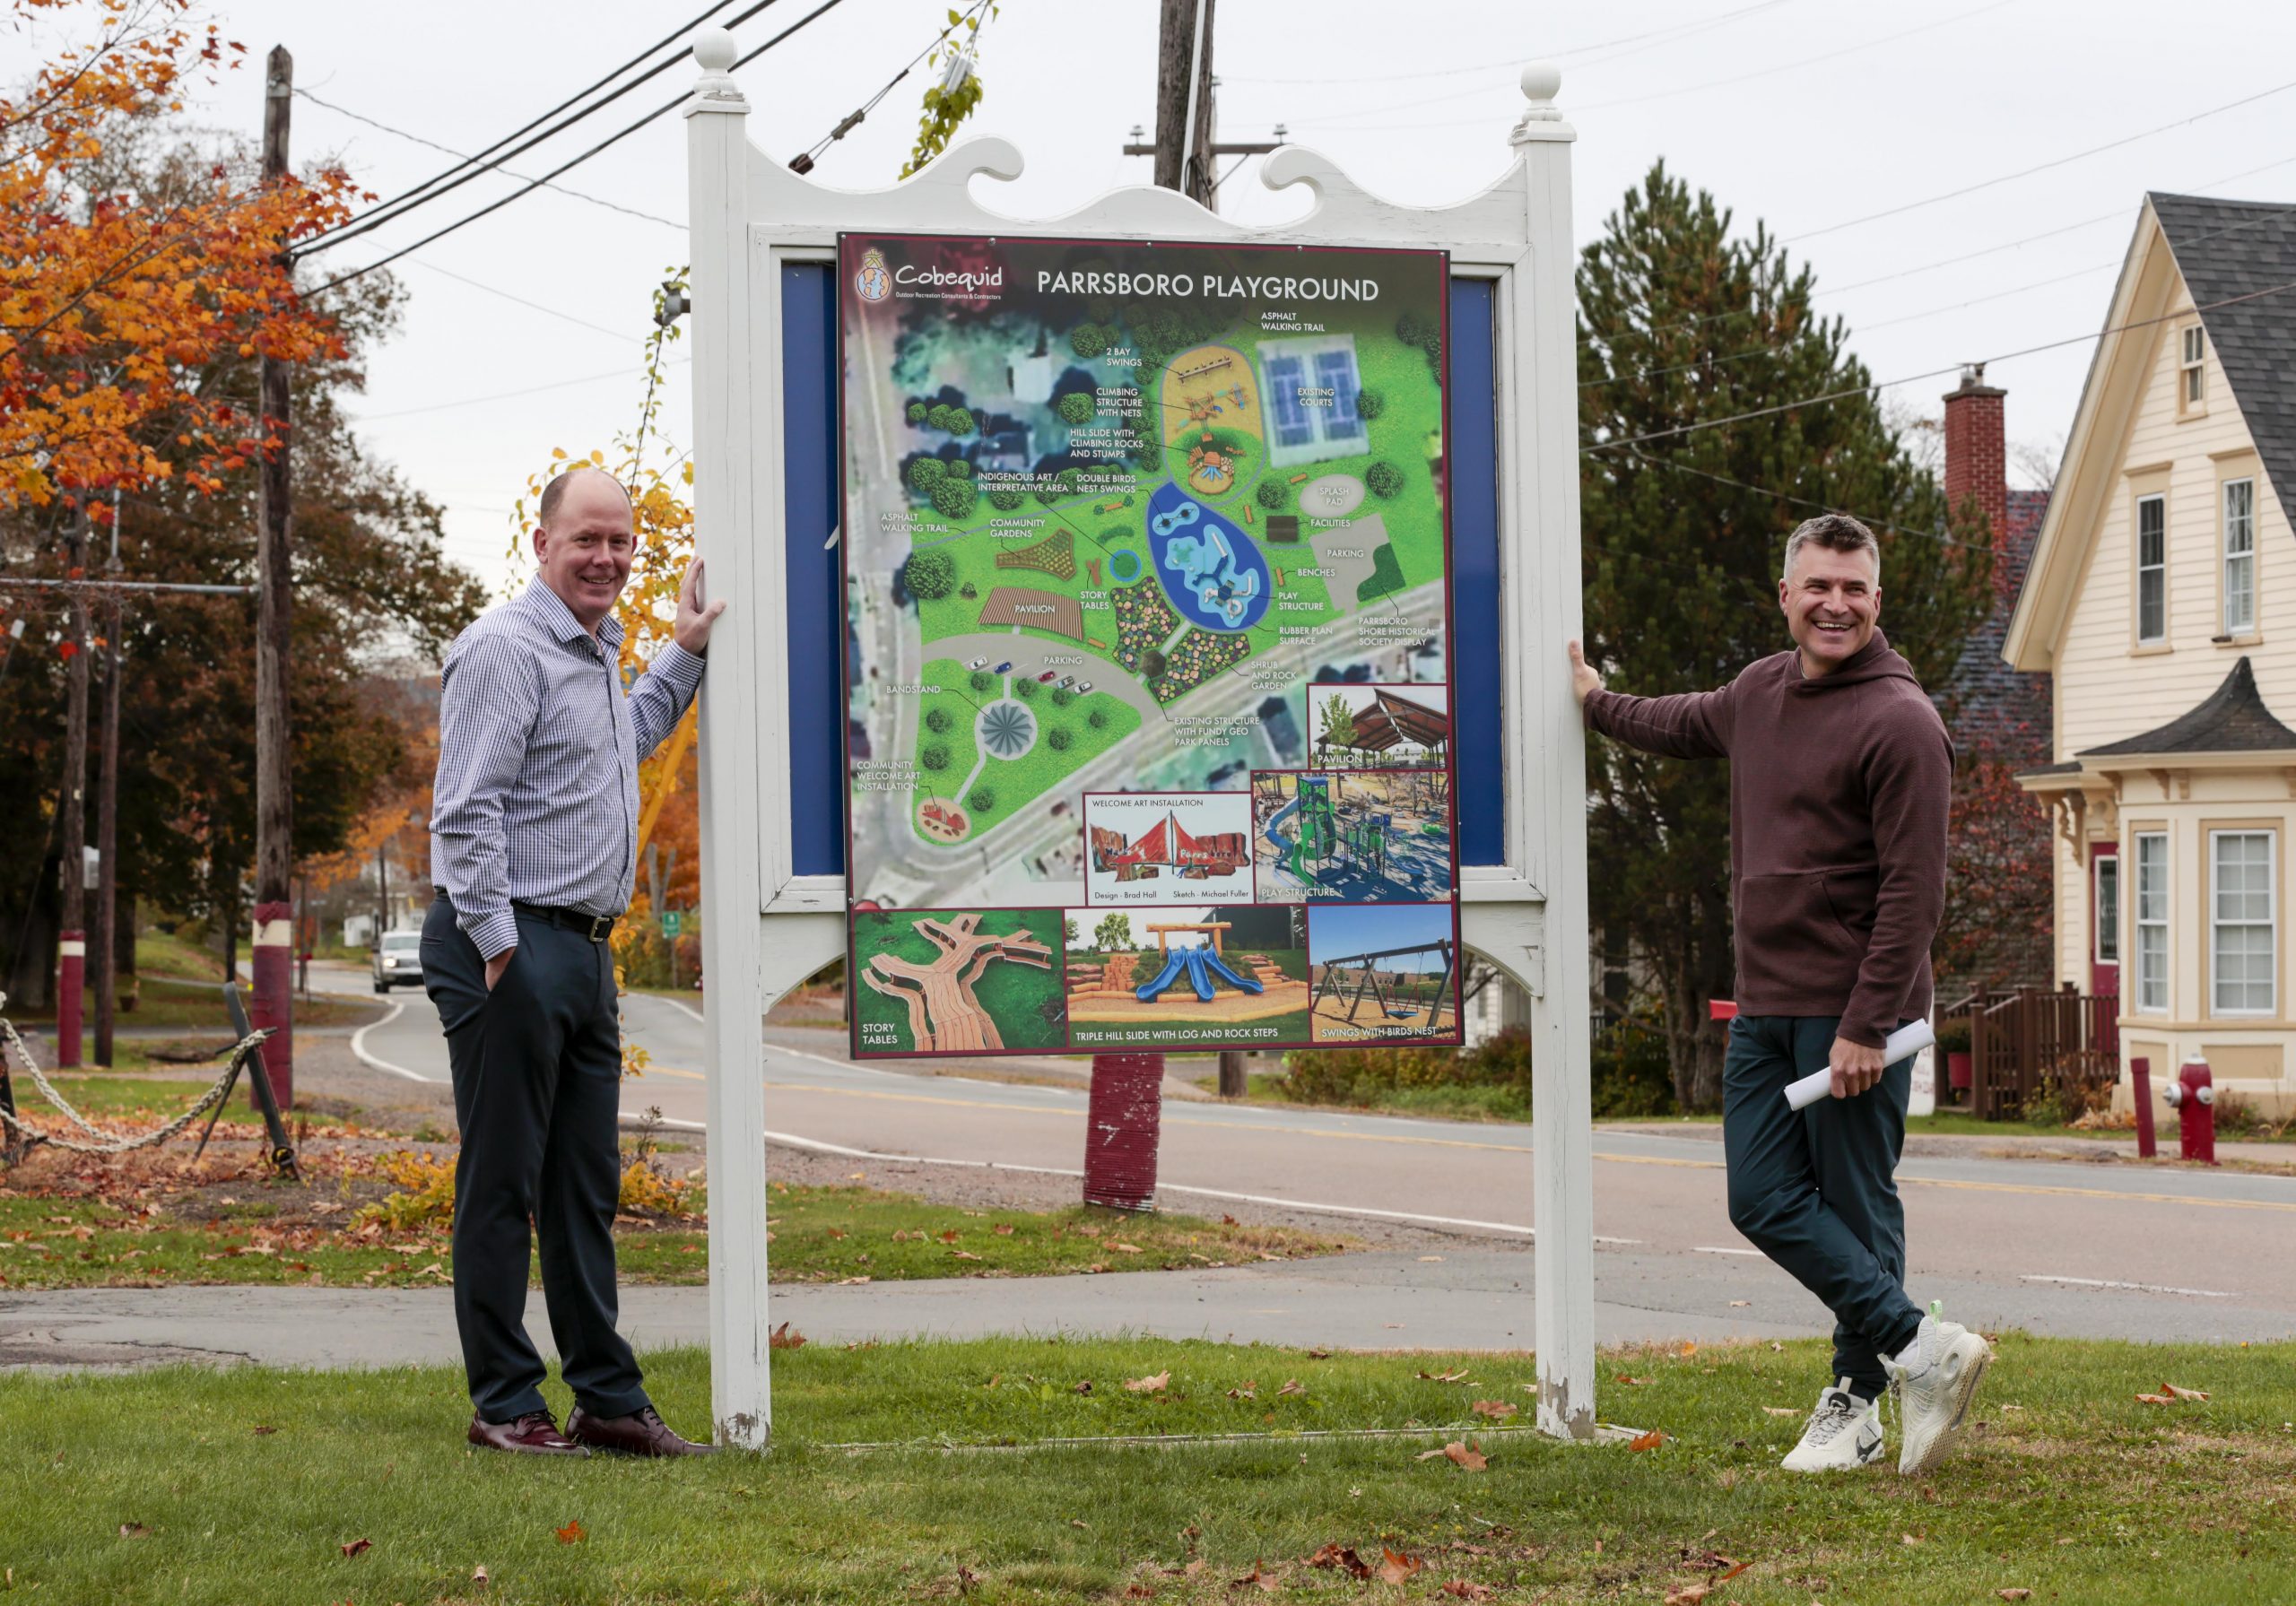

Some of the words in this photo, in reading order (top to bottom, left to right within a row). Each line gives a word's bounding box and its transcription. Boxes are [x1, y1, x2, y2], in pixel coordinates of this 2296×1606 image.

[896, 265, 1002, 292] Cobequid
[1038, 271, 1194, 296] PARRSBORO
[1204, 275, 1378, 300] PLAYGROUND
[1261, 312, 1296, 321] ASPHALT
[1261, 323, 1301, 332] WALKING
[1304, 323, 1326, 332] TRAIL
[1115, 348, 1130, 356] BAY
[1107, 359, 1142, 367] SWINGS
[1097, 388, 1138, 396] CLIMBING
[1298, 388, 1335, 396] EXISTING
[1097, 398, 1143, 406] STRUCTURE
[1300, 398, 1333, 406] COURTS
[1071, 429, 1086, 437] HILL
[1071, 439, 1112, 447] CLIMBING
[1115, 440, 1144, 448] ROCKS
[1092, 450, 1125, 458] STUMPS
[978, 473, 1034, 482] INDIGENOUS
[1037, 473, 1053, 482] ART
[1077, 474, 1110, 482] DOUBLE
[1113, 475, 1136, 483] BIRDS
[978, 483, 1044, 492] INTERPRETATIVE
[1046, 484, 1069, 492] AREA
[1077, 484, 1099, 493] NEST
[1100, 485, 1135, 493] SWINGS
[1320, 488, 1349, 496] SPLASH
[1326, 498, 1342, 506] PAD
[881, 513, 918, 522] ASPHALT
[990, 519, 1045, 527] COMMUNITY
[1311, 519, 1350, 527] FACILITIES
[881, 524, 924, 533] WALKING
[926, 525, 948, 533] TRAIL
[990, 529, 1032, 538] GARDENS
[1327, 550, 1364, 558] PARKING
[1298, 569, 1335, 577] BENCHES
[1081, 591, 1107, 599] STORY
[1279, 592, 1298, 600] PLAY
[1081, 602, 1109, 610] TABLES
[1279, 603, 1324, 611] STRUCTURE
[1280, 627, 1309, 635] RUBBER
[1312, 627, 1333, 635] PLAN
[1359, 628, 1387, 636] SHORE
[1389, 628, 1435, 636] HISTORICAL
[1359, 638, 1392, 647] SOCIETY
[1044, 656, 1083, 664] PARKING
[1251, 661, 1278, 669] SHRUB
[1251, 672, 1270, 680] AND
[1274, 672, 1297, 680] ROCK
[886, 686, 941, 694] BANDSTAND
[1175, 717, 1211, 725] EXISTING
[1214, 717, 1260, 725] STRUCTURE
[1318, 755, 1362, 763] PAVILION
[857, 772, 902, 780] WELCOME
[857, 783, 918, 791] INSTALLATION
[1095, 892, 1118, 900] Design
[1286, 889, 1335, 897] STRUCTURE
[863, 1023, 895, 1032] STORY
[1076, 1032, 1103, 1041] TRIPLE
[1106, 1032, 1124, 1040] HILL
[1126, 1031, 1150, 1040] SLIDE
[1152, 1031, 1176, 1039] WITH
[1178, 1030, 1198, 1038] LOG
[1201, 1029, 1222, 1038] AND
[1225, 1029, 1251, 1037] ROCK
[1254, 1029, 1278, 1037] STEPS
[1322, 1029, 1360, 1037] SWINGS
[1362, 1028, 1385, 1036] WITH
[1387, 1028, 1412, 1036] BIRDS
[1415, 1027, 1436, 1036] NEST
[863, 1036, 898, 1044] TABLES
